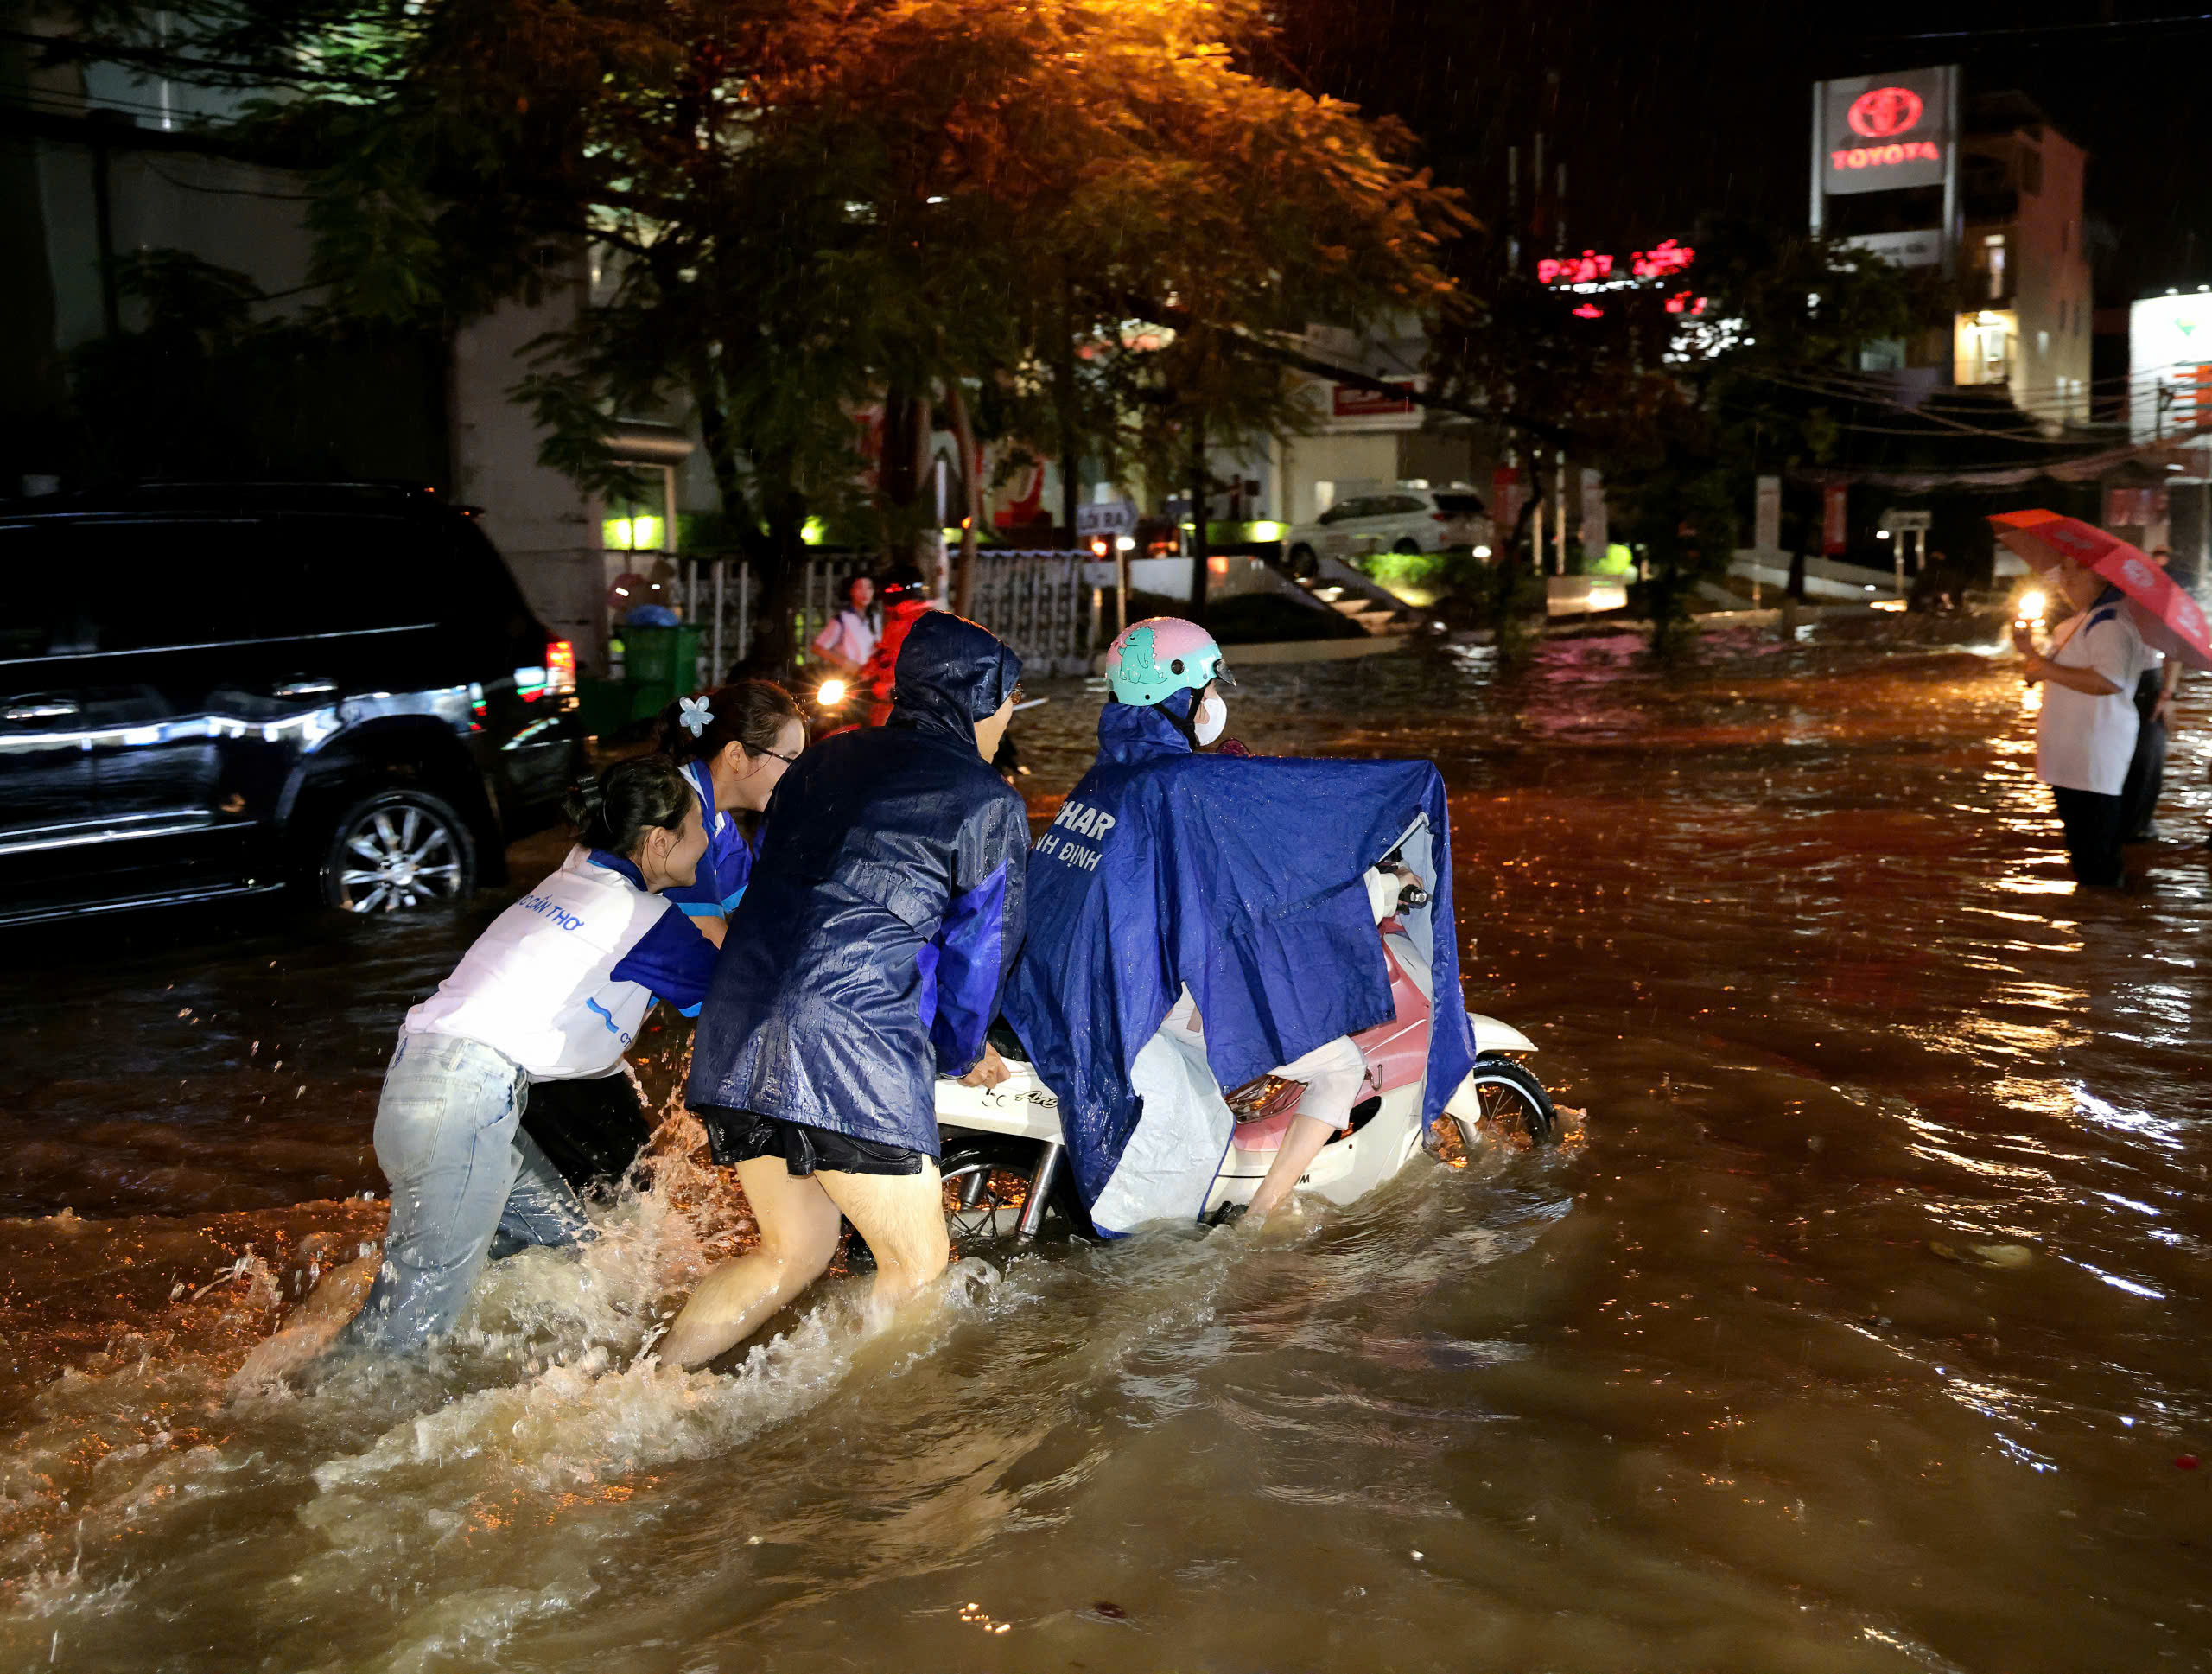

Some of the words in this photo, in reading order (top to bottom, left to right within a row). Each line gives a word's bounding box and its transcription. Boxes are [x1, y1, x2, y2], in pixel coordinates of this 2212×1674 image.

[1831, 142, 1939, 169] TOYOTA
[1055, 800, 1116, 840] HAR
[1058, 842, 1103, 871] ĐỊNH
[545, 905, 585, 930] THƠ
